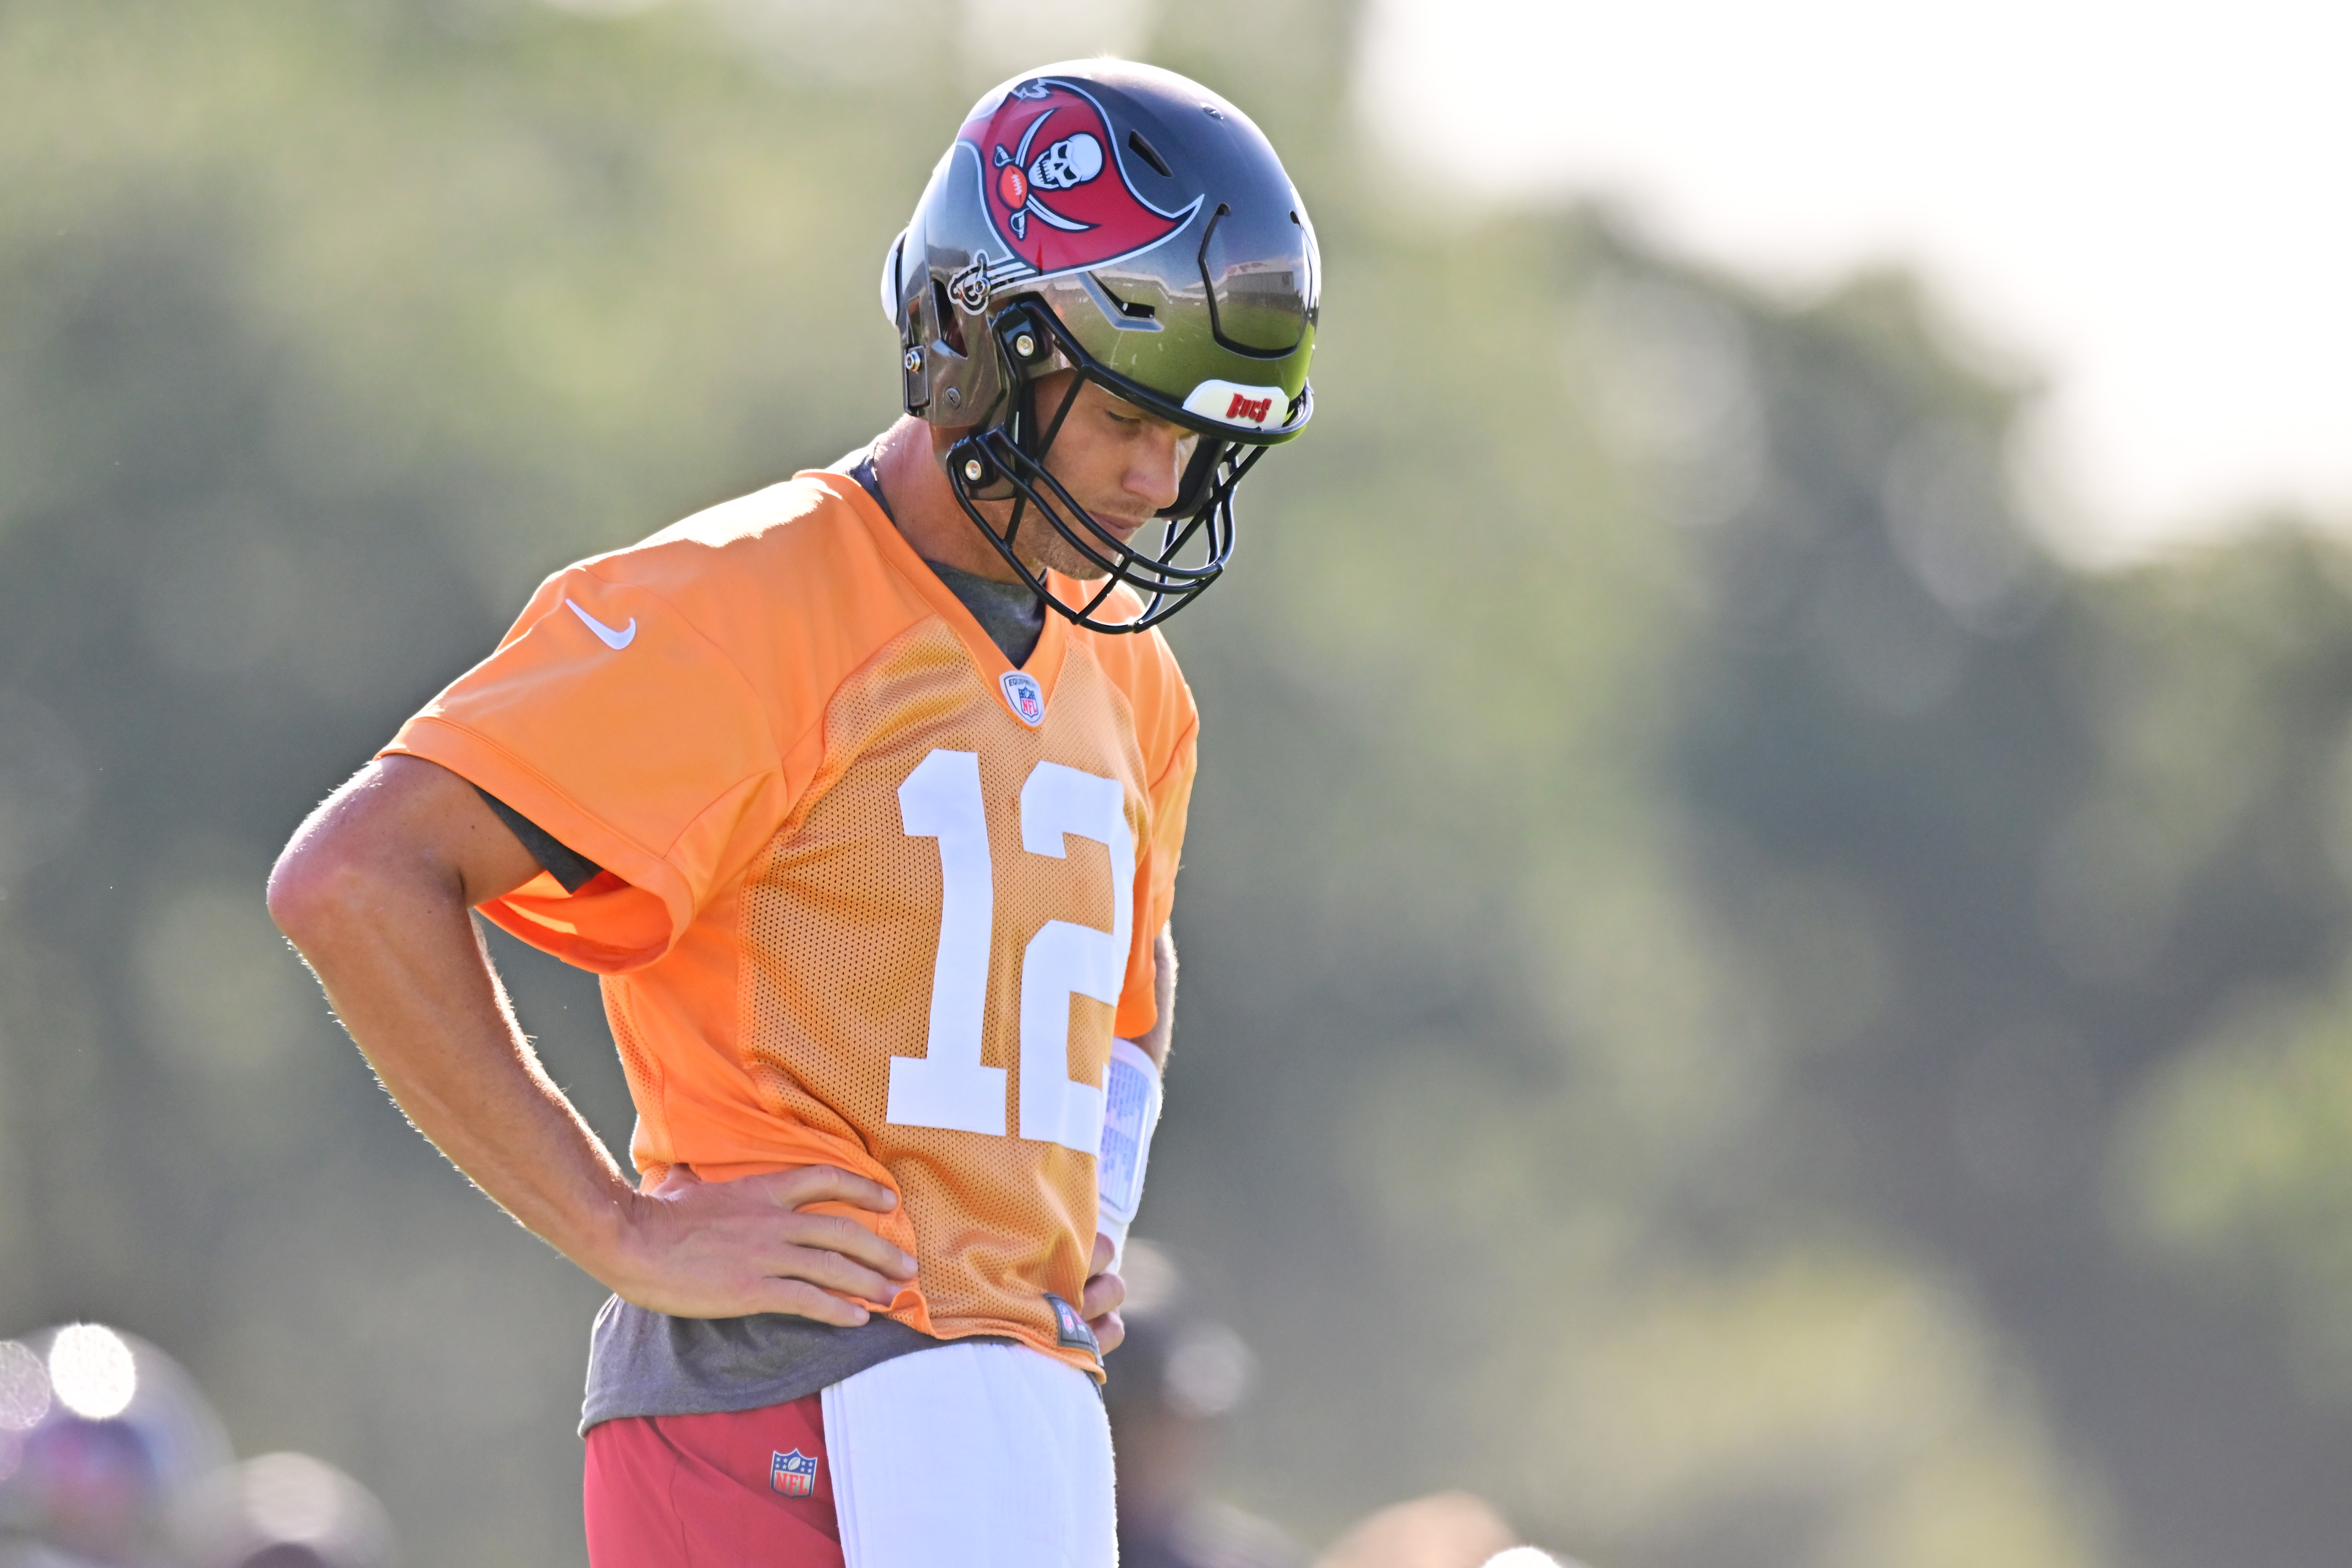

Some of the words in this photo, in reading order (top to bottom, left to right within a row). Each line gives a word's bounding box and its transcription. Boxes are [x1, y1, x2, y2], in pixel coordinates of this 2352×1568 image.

[1021, 699, 1038, 714] NFL
[886, 748, 1135, 1159] 12
[775, 1472, 808, 1495] NFL
